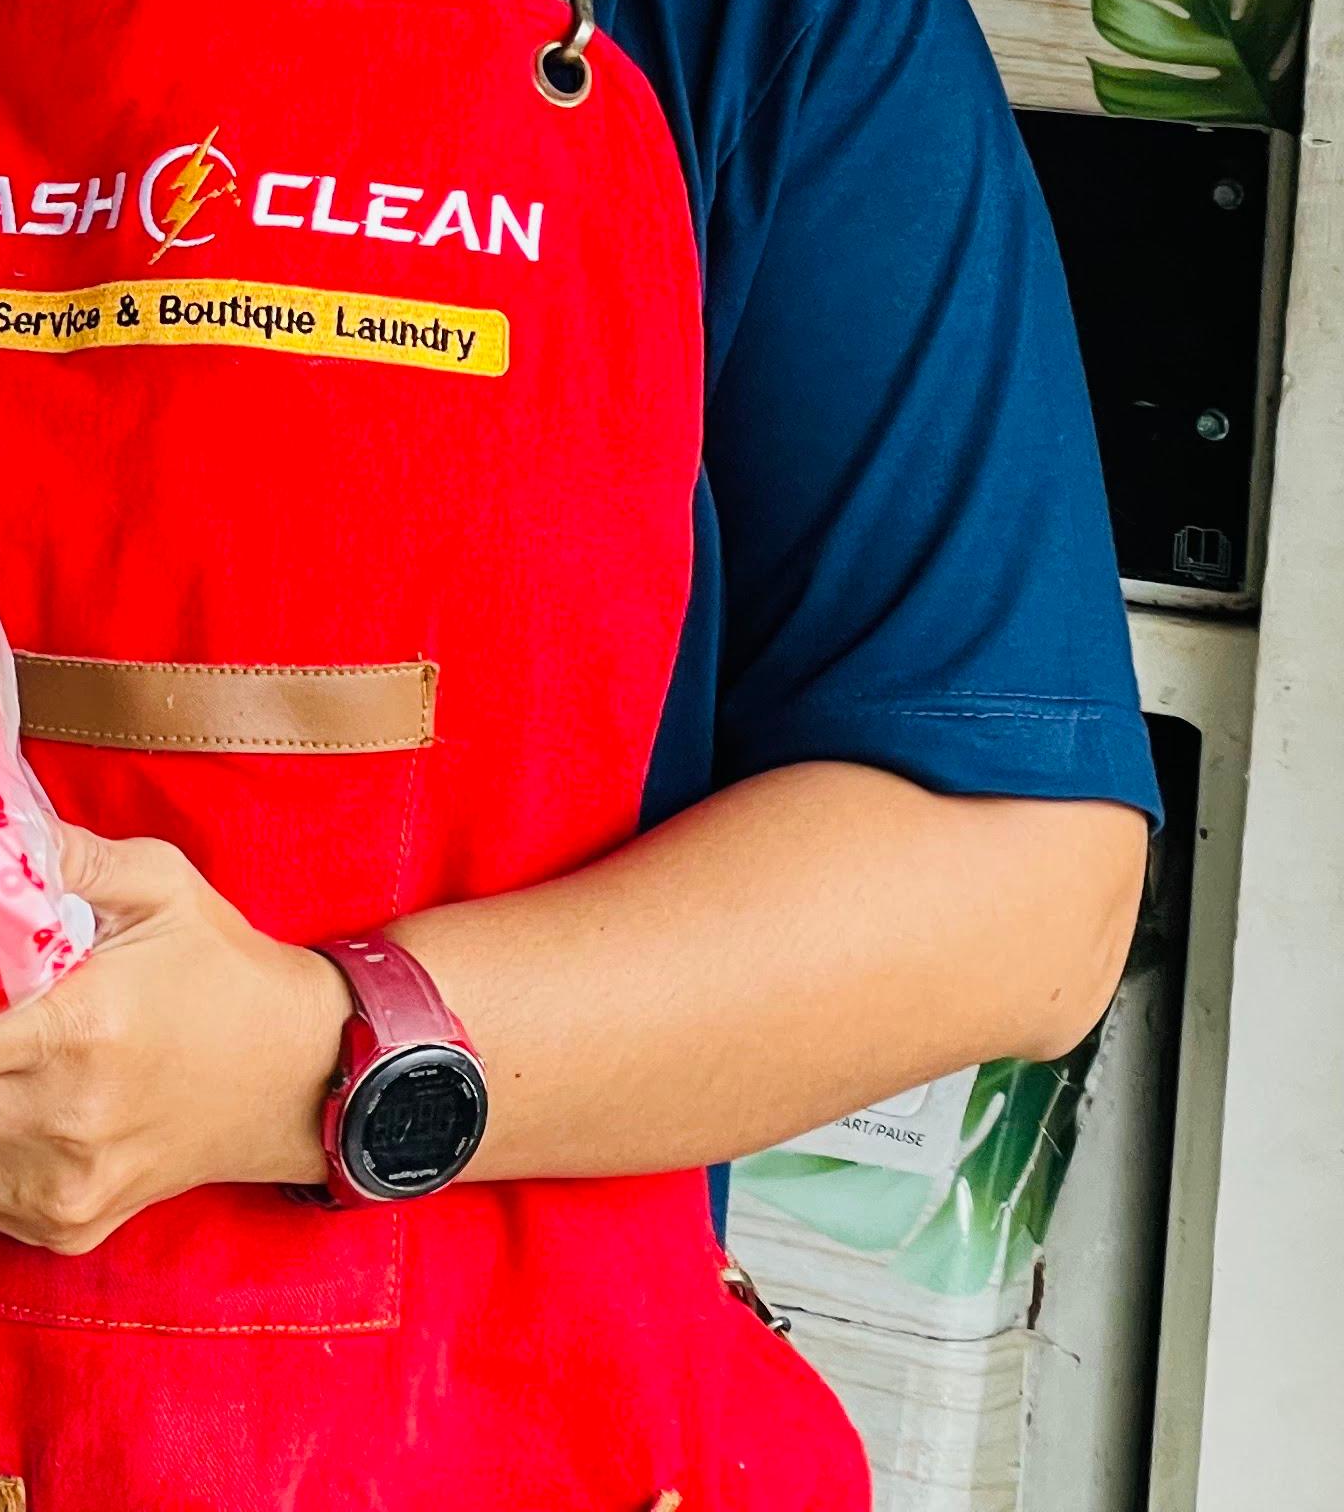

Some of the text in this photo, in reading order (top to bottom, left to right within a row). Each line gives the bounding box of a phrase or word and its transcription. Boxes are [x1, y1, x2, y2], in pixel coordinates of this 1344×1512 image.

[252, 173, 544, 262] CLEAN
[116, 295, 141, 328] &
[159, 295, 316, 336] Boutique
[336, 306, 477, 361] Laundry
[834, 1115, 926, 1148] ART/PAUSE
